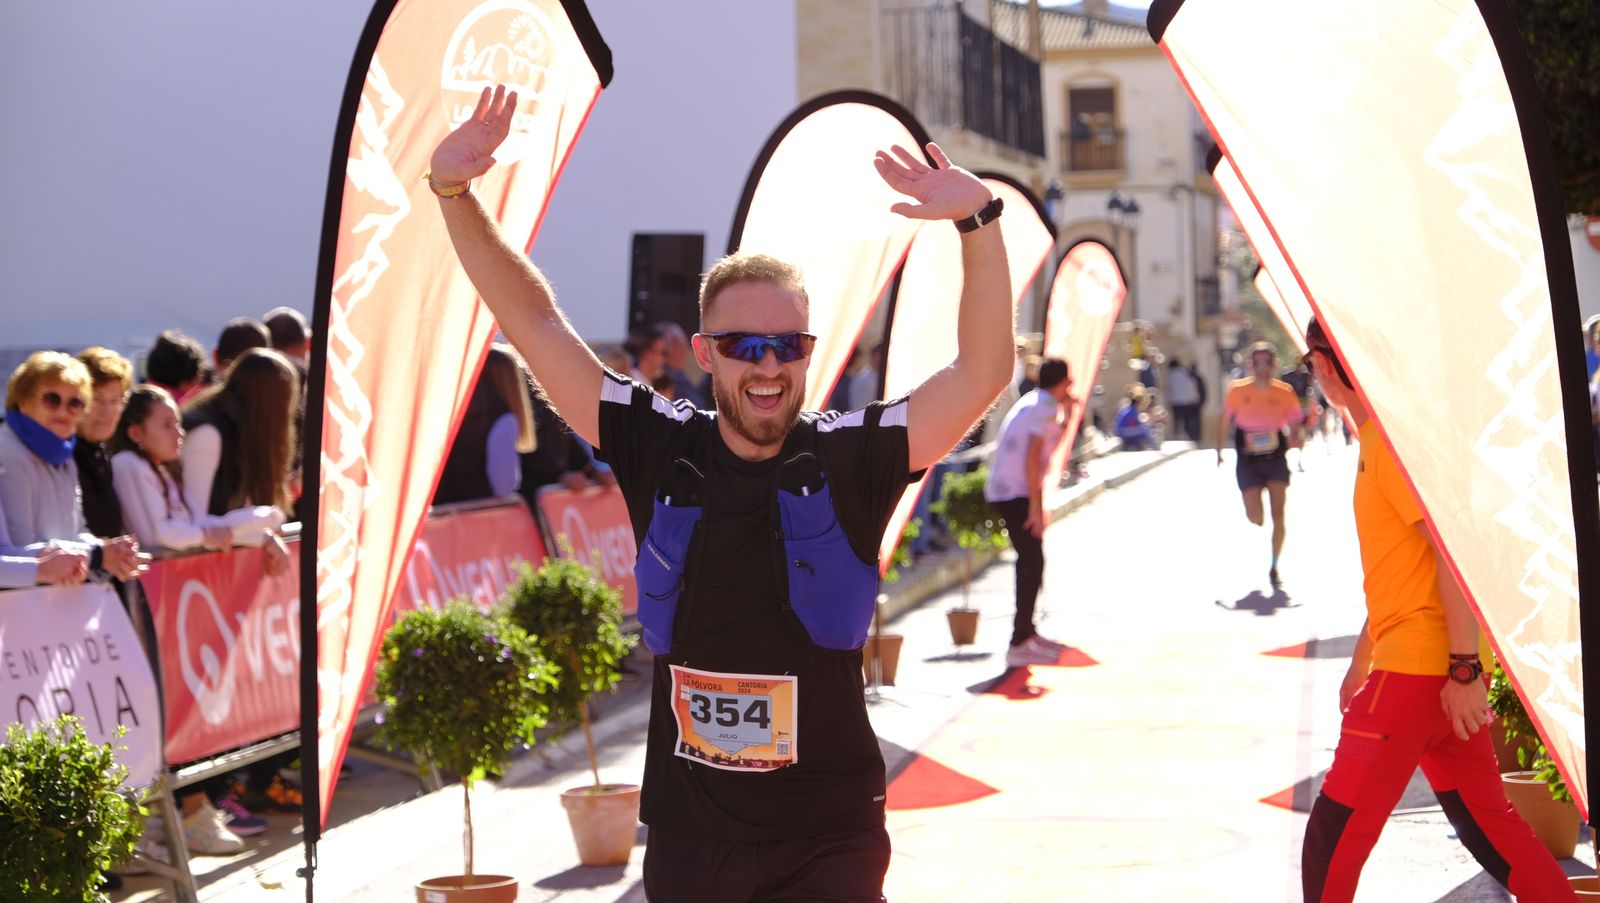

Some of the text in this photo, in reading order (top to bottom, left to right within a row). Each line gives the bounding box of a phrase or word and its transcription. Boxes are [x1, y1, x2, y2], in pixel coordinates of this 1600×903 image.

[84, 633, 121, 665] DE
[737, 681, 768, 689] CANTORIA
[690, 693, 771, 729] 354
